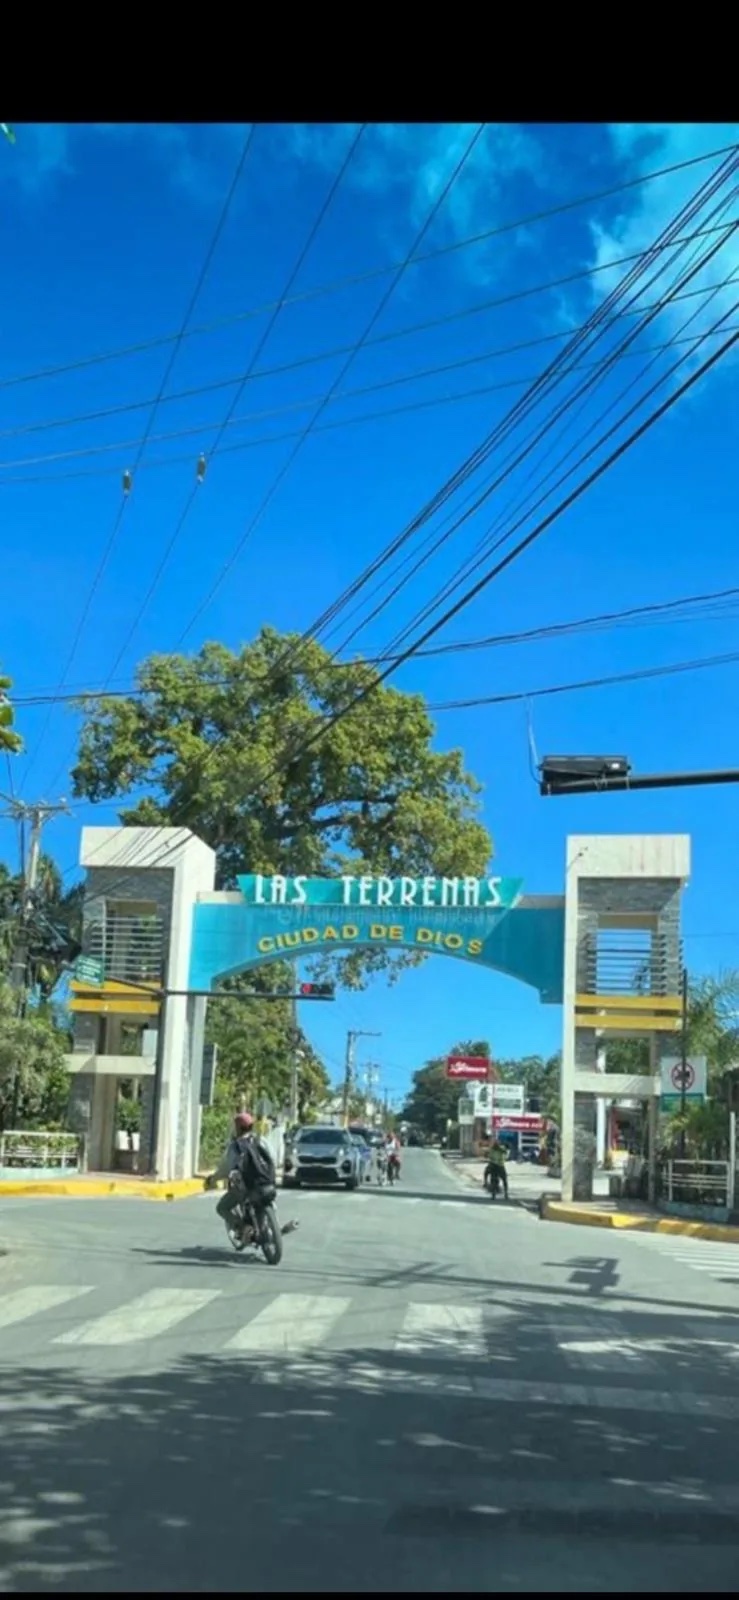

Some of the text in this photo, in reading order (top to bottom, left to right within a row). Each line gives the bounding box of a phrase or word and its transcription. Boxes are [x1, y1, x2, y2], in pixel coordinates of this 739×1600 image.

[254, 874, 501, 906] LAS TERRENAS
[258, 924, 483, 954] CIUDAD DE DIOS
